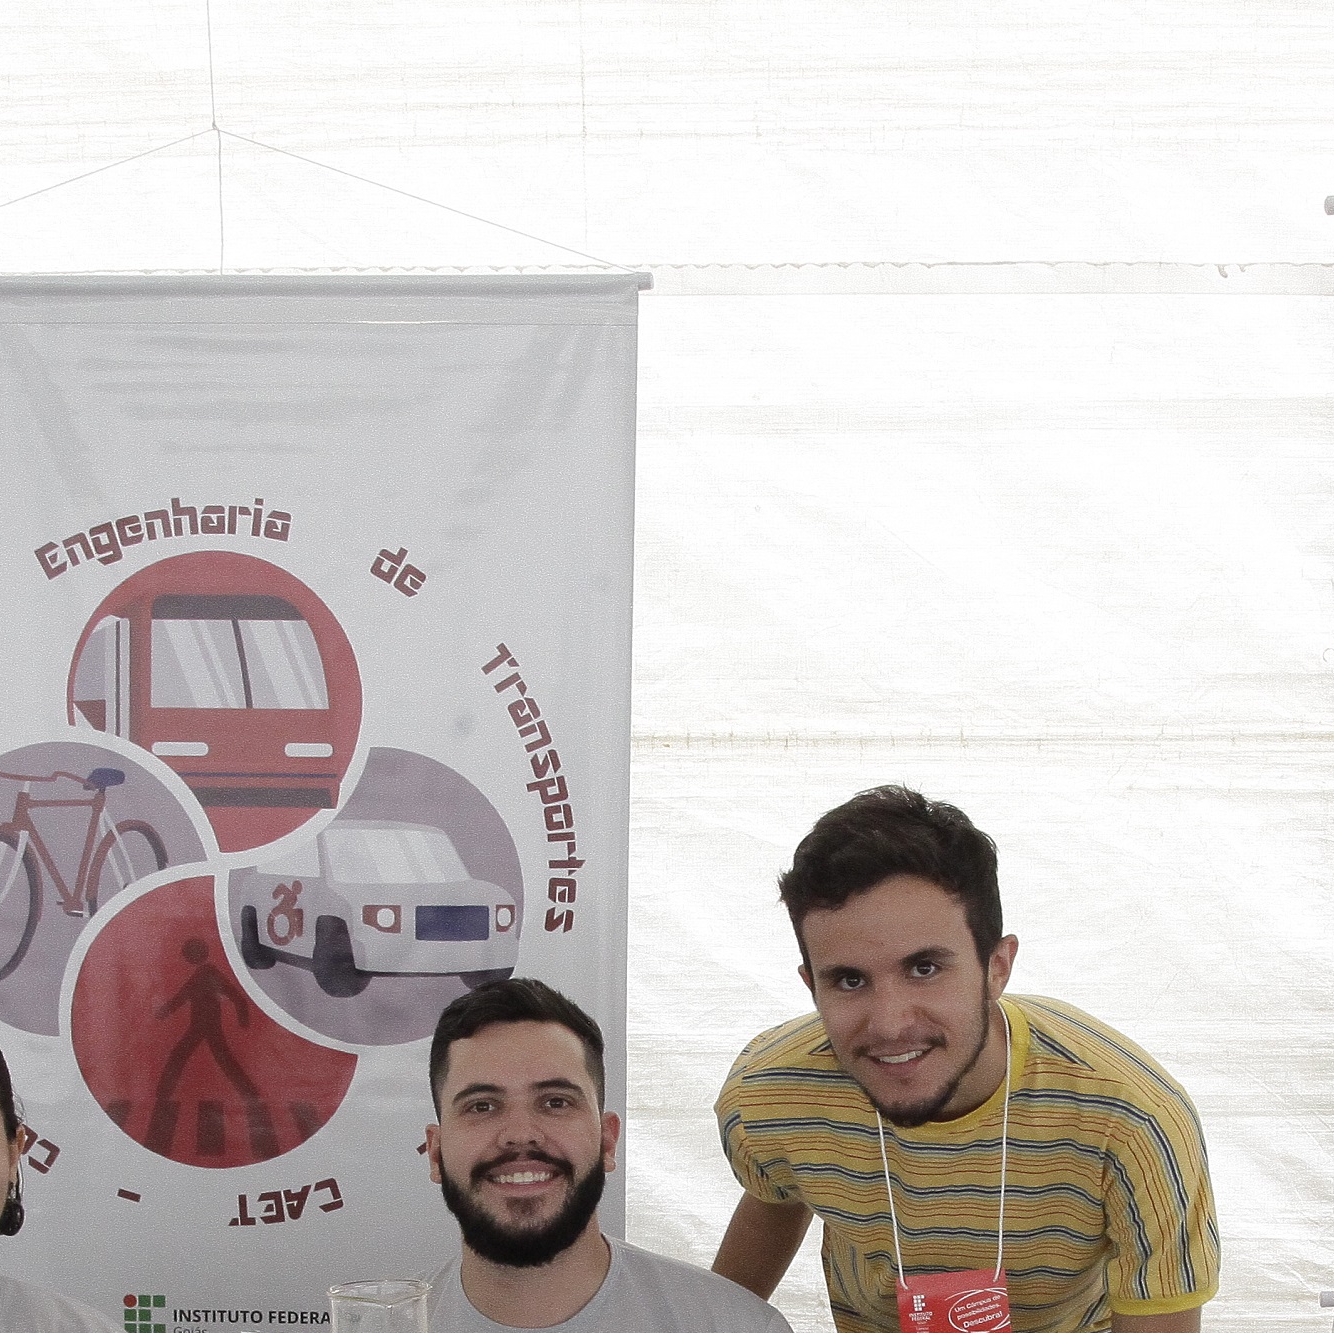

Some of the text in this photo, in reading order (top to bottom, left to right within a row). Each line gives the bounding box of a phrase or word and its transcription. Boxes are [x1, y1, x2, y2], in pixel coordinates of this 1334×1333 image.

[35, 497, 586, 934] Engenharia de Transportes
[229, 1177, 344, 1226] CAET
[173, 1309, 331, 1325] INSTITUTO FEDERA
